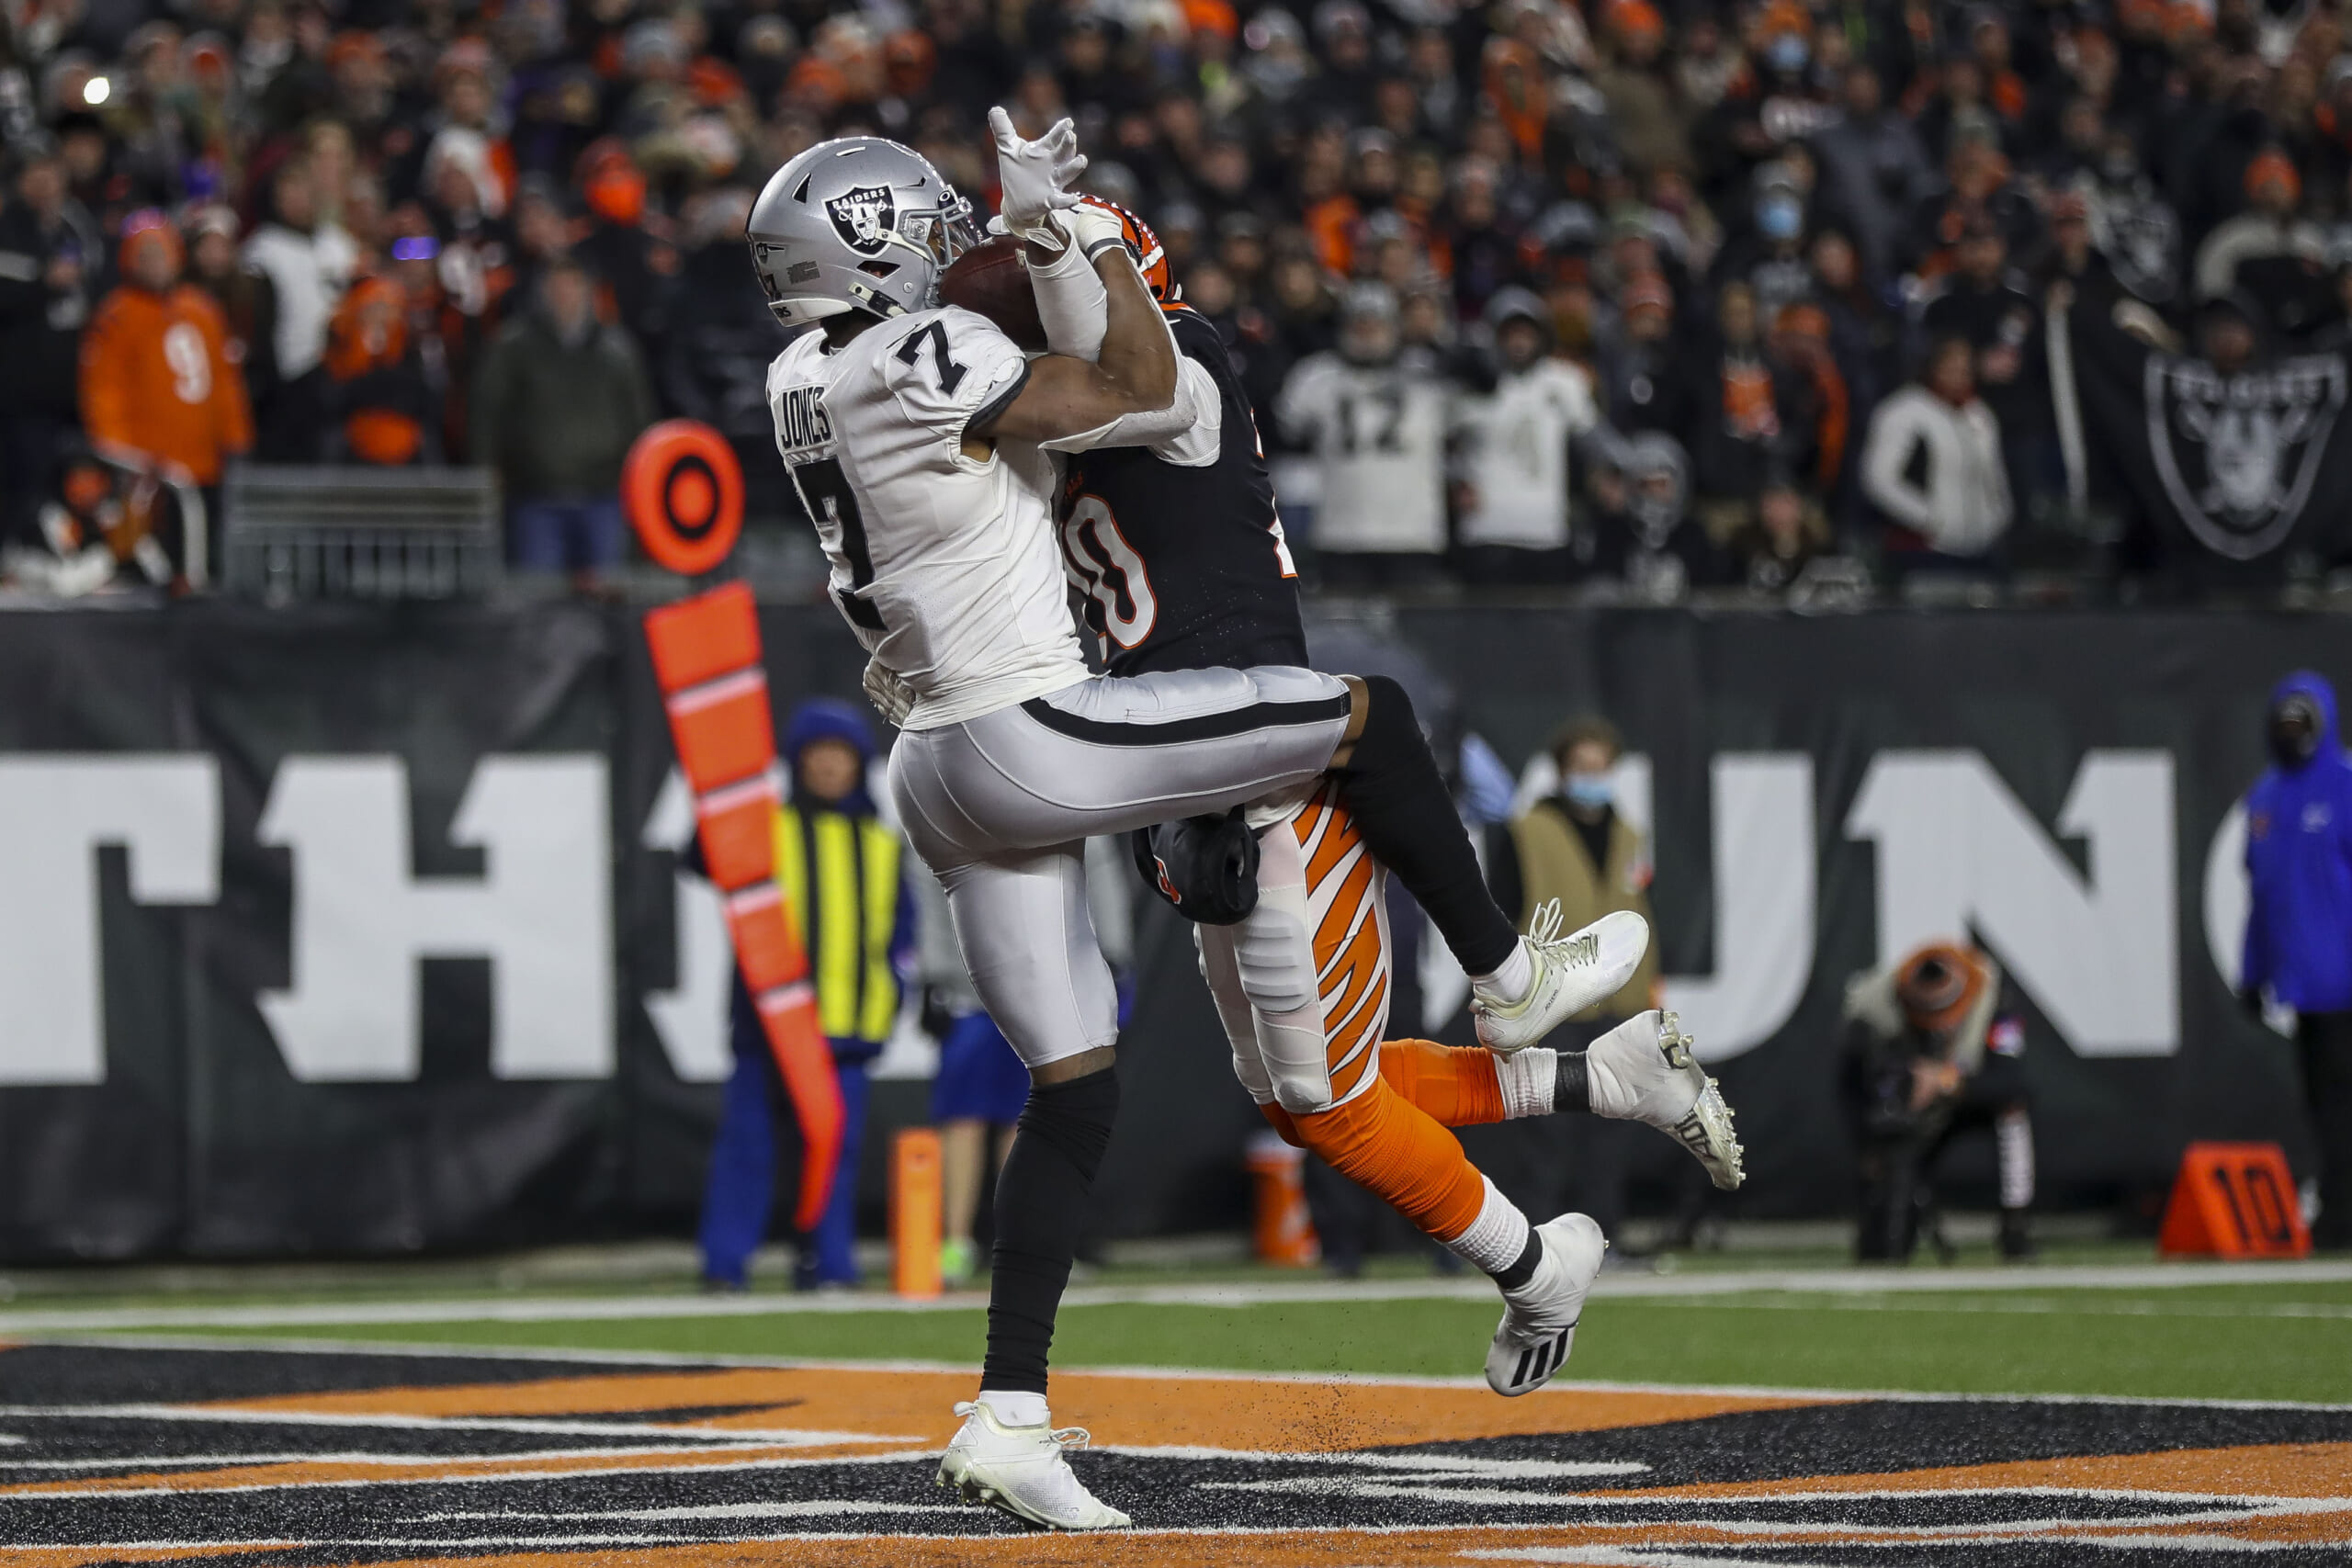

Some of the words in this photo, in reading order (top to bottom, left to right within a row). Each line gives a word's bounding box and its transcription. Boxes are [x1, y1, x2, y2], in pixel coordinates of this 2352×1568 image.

[831, 188, 886, 209] RAIDERS
[163, 321, 212, 403] 9
[892, 321, 971, 397] 7
[780, 386, 831, 449] JONES
[793, 456, 889, 634] 7
[2212, 1164, 2293, 1246] 10
